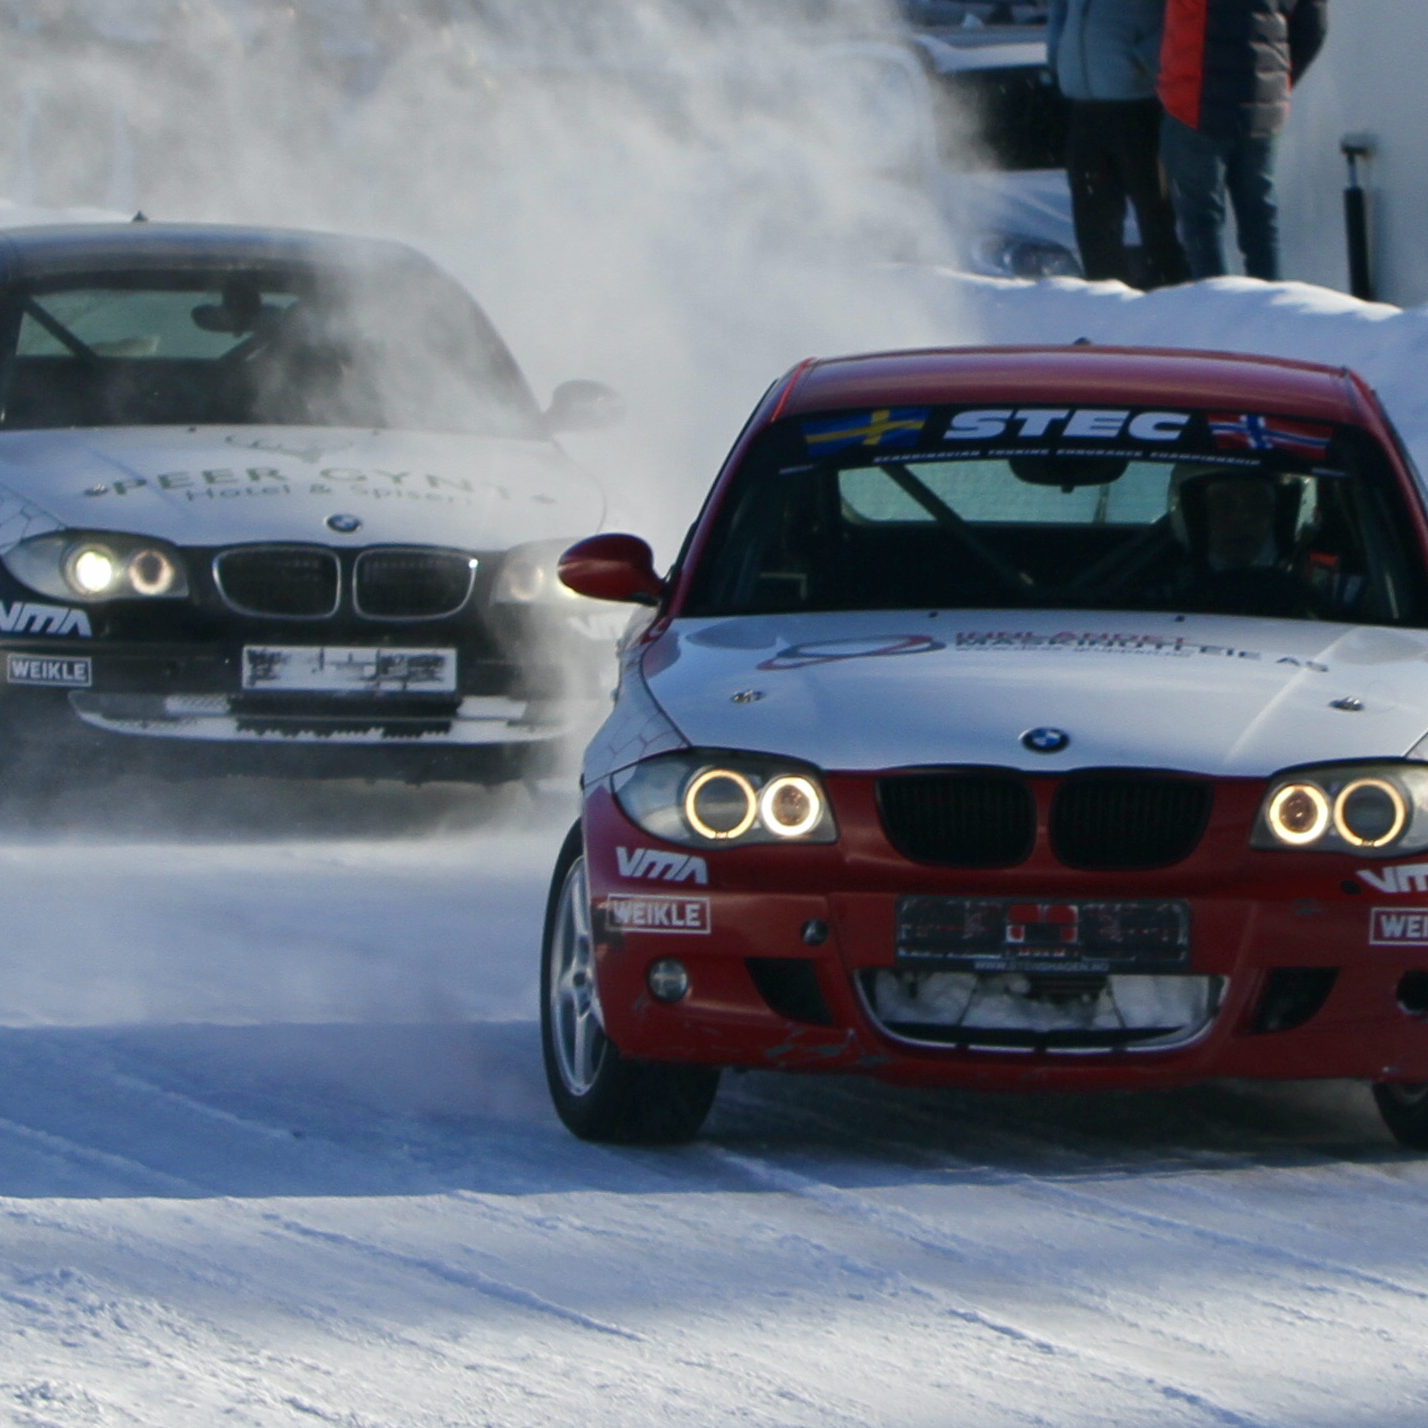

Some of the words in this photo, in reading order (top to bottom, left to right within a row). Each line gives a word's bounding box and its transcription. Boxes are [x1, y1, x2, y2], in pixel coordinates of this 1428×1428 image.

[943, 408, 1194, 442] STEC
[113, 466, 289, 496] PEER
[185, 482, 292, 502] Hotel
[11, 659, 87, 681] WEIKLE
[615, 845, 709, 885] VMA
[612, 900, 701, 927] WEIKLE
